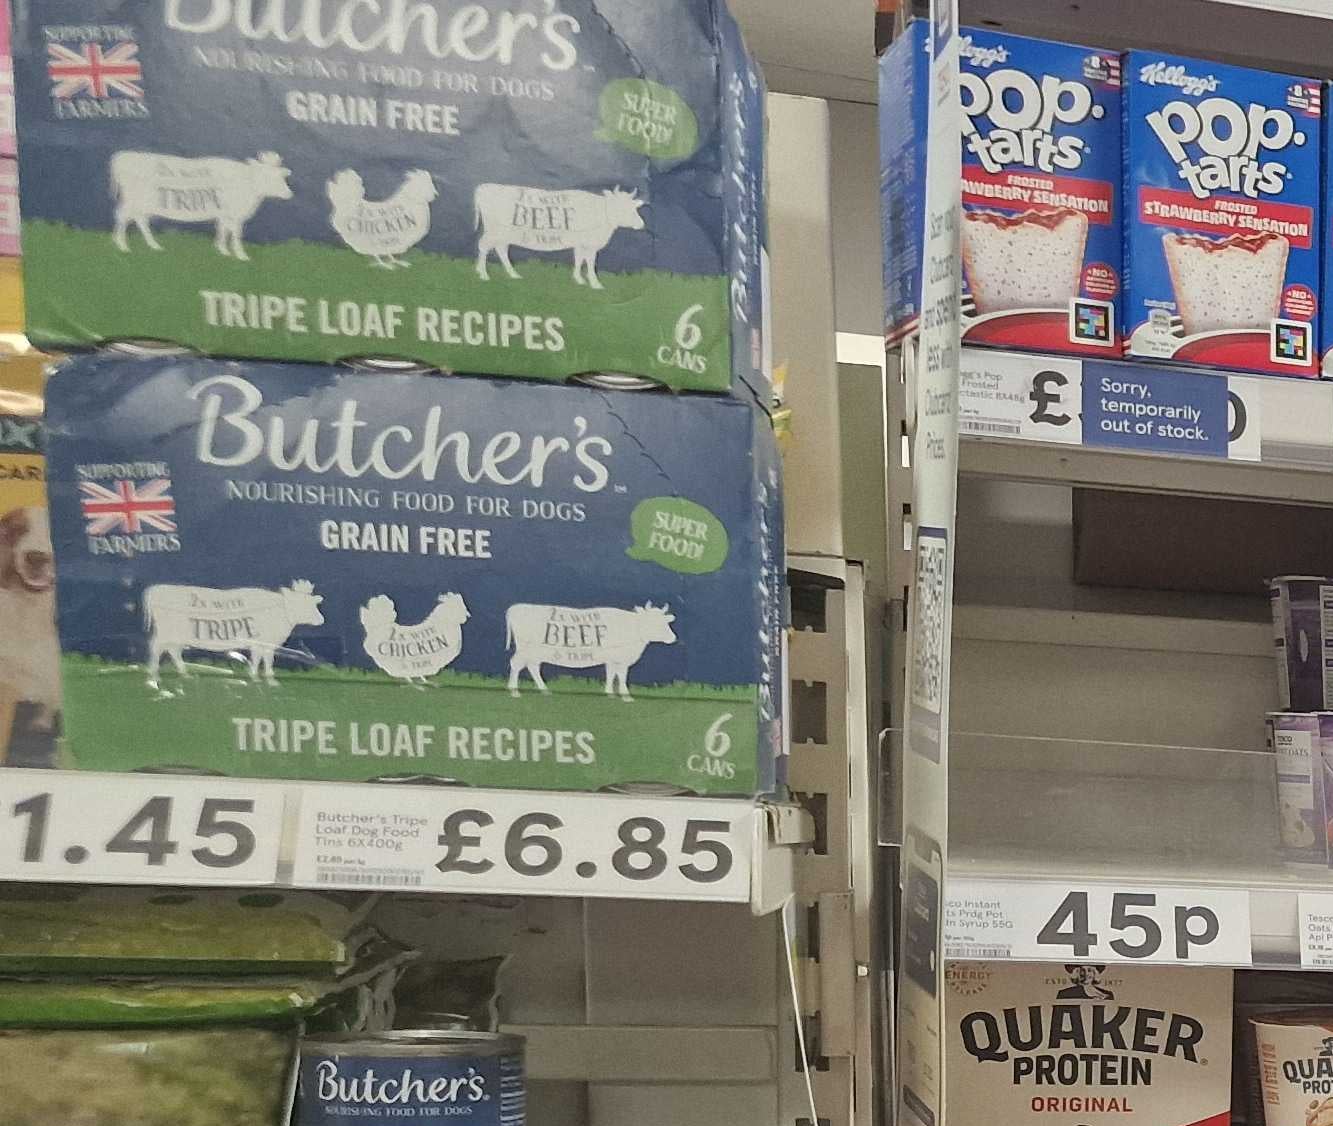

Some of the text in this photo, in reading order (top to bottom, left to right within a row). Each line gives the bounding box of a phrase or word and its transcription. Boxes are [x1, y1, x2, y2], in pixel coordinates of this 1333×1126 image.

[1139, 62, 1221, 94] Kellogg's
[1178, 156, 1293, 198] tarts
[1144, 200, 1308, 237] STRAWBERRY SENSATION
[1101, 375, 1152, 398] Sorry,
[1101, 395, 1201, 425] temporarily
[188, 375, 616, 492] Butcher's
[1100, 417, 1209, 441] out of stock.
[227, 480, 585, 522] NOURISHING FOOD FOR DOGS
[320, 520, 491, 558] GRAIN FREE
[542, 623, 606, 648] BEEF
[233, 718, 596, 766] TRIPE LOAF RECIPES
[316, 823, 420, 837] Loaf Dog Food
[317, 811, 428, 826] Butcher's Tripe
[435, 808, 732, 883] £6.85
[1036, 891, 1220, 958] 45p
[960, 1005, 1205, 1066] QUAKER
[316, 1058, 485, 1106] Butcher's
[1013, 1053, 1153, 1087] PROTEIN
[1031, 1096, 1133, 1113] ORIGINAL
